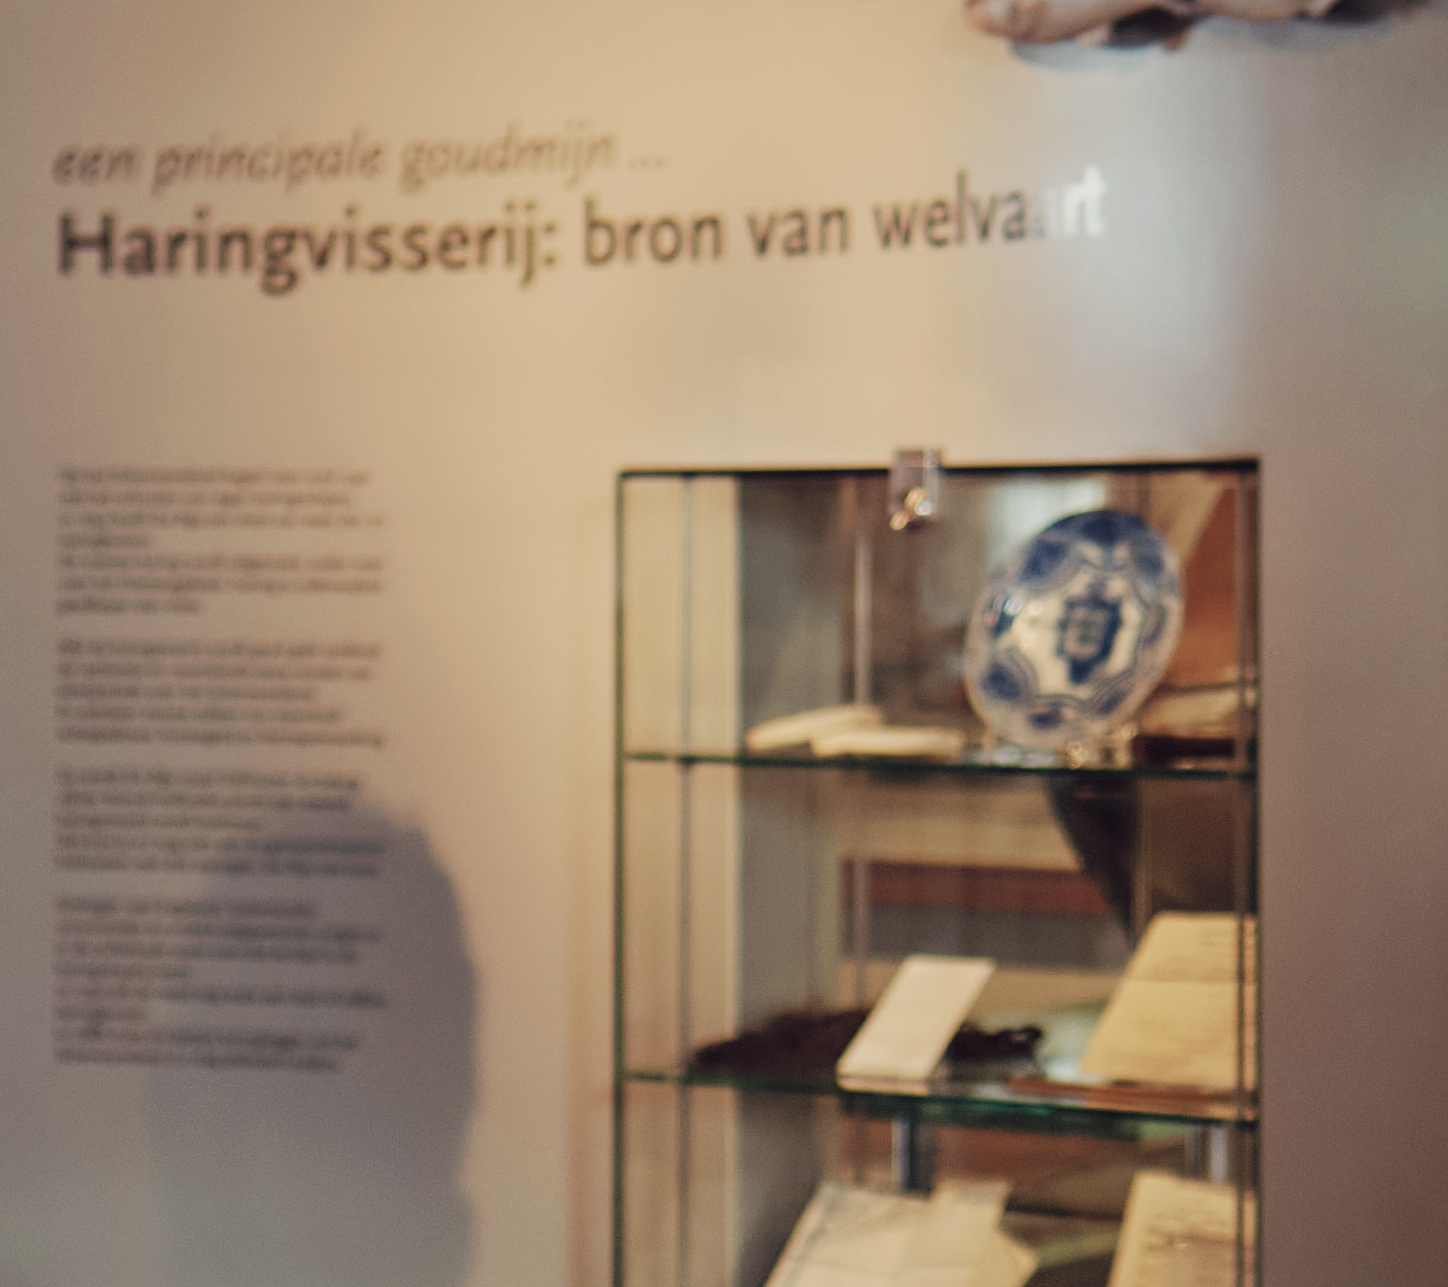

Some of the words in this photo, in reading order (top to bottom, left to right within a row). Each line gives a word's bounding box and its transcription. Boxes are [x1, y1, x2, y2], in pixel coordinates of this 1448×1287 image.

[54, 142, 139, 187] een
[152, 129, 386, 196] principale
[398, 117, 618, 195] goudmijn
[58, 199, 560, 298] Haringvisserij:
[582, 197, 724, 267] bron
[745, 205, 849, 259] van
